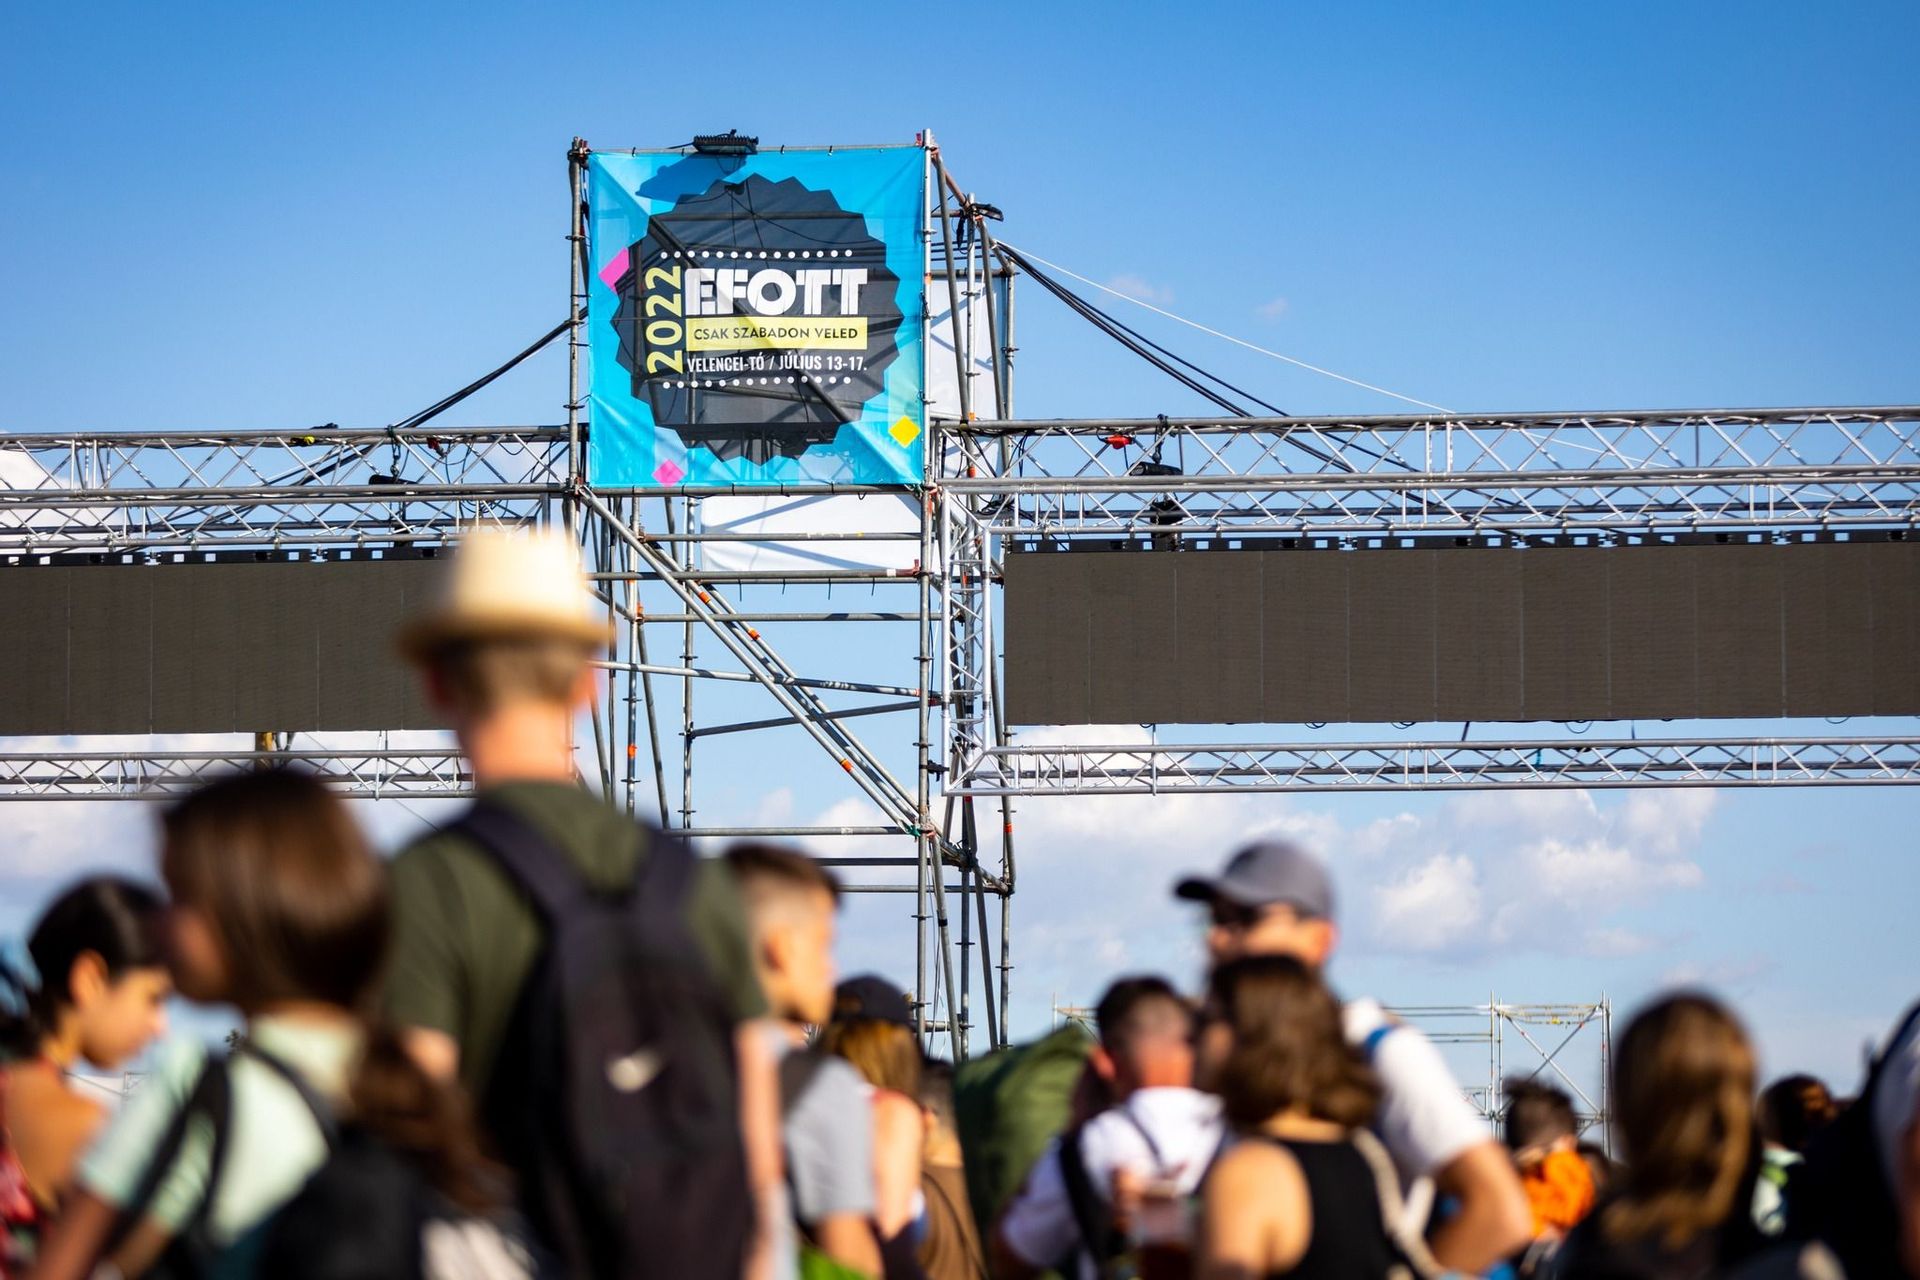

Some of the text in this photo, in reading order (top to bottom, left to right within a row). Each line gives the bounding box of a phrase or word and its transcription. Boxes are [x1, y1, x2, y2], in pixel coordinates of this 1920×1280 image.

[685, 268, 868, 316] EFOTT
[645, 265, 683, 374] 2022
[694, 327, 858, 341] CSAK SZABADON VELED
[687, 351, 868, 373] VELENCEI-TÓ / JÚLIUS 13-17.
